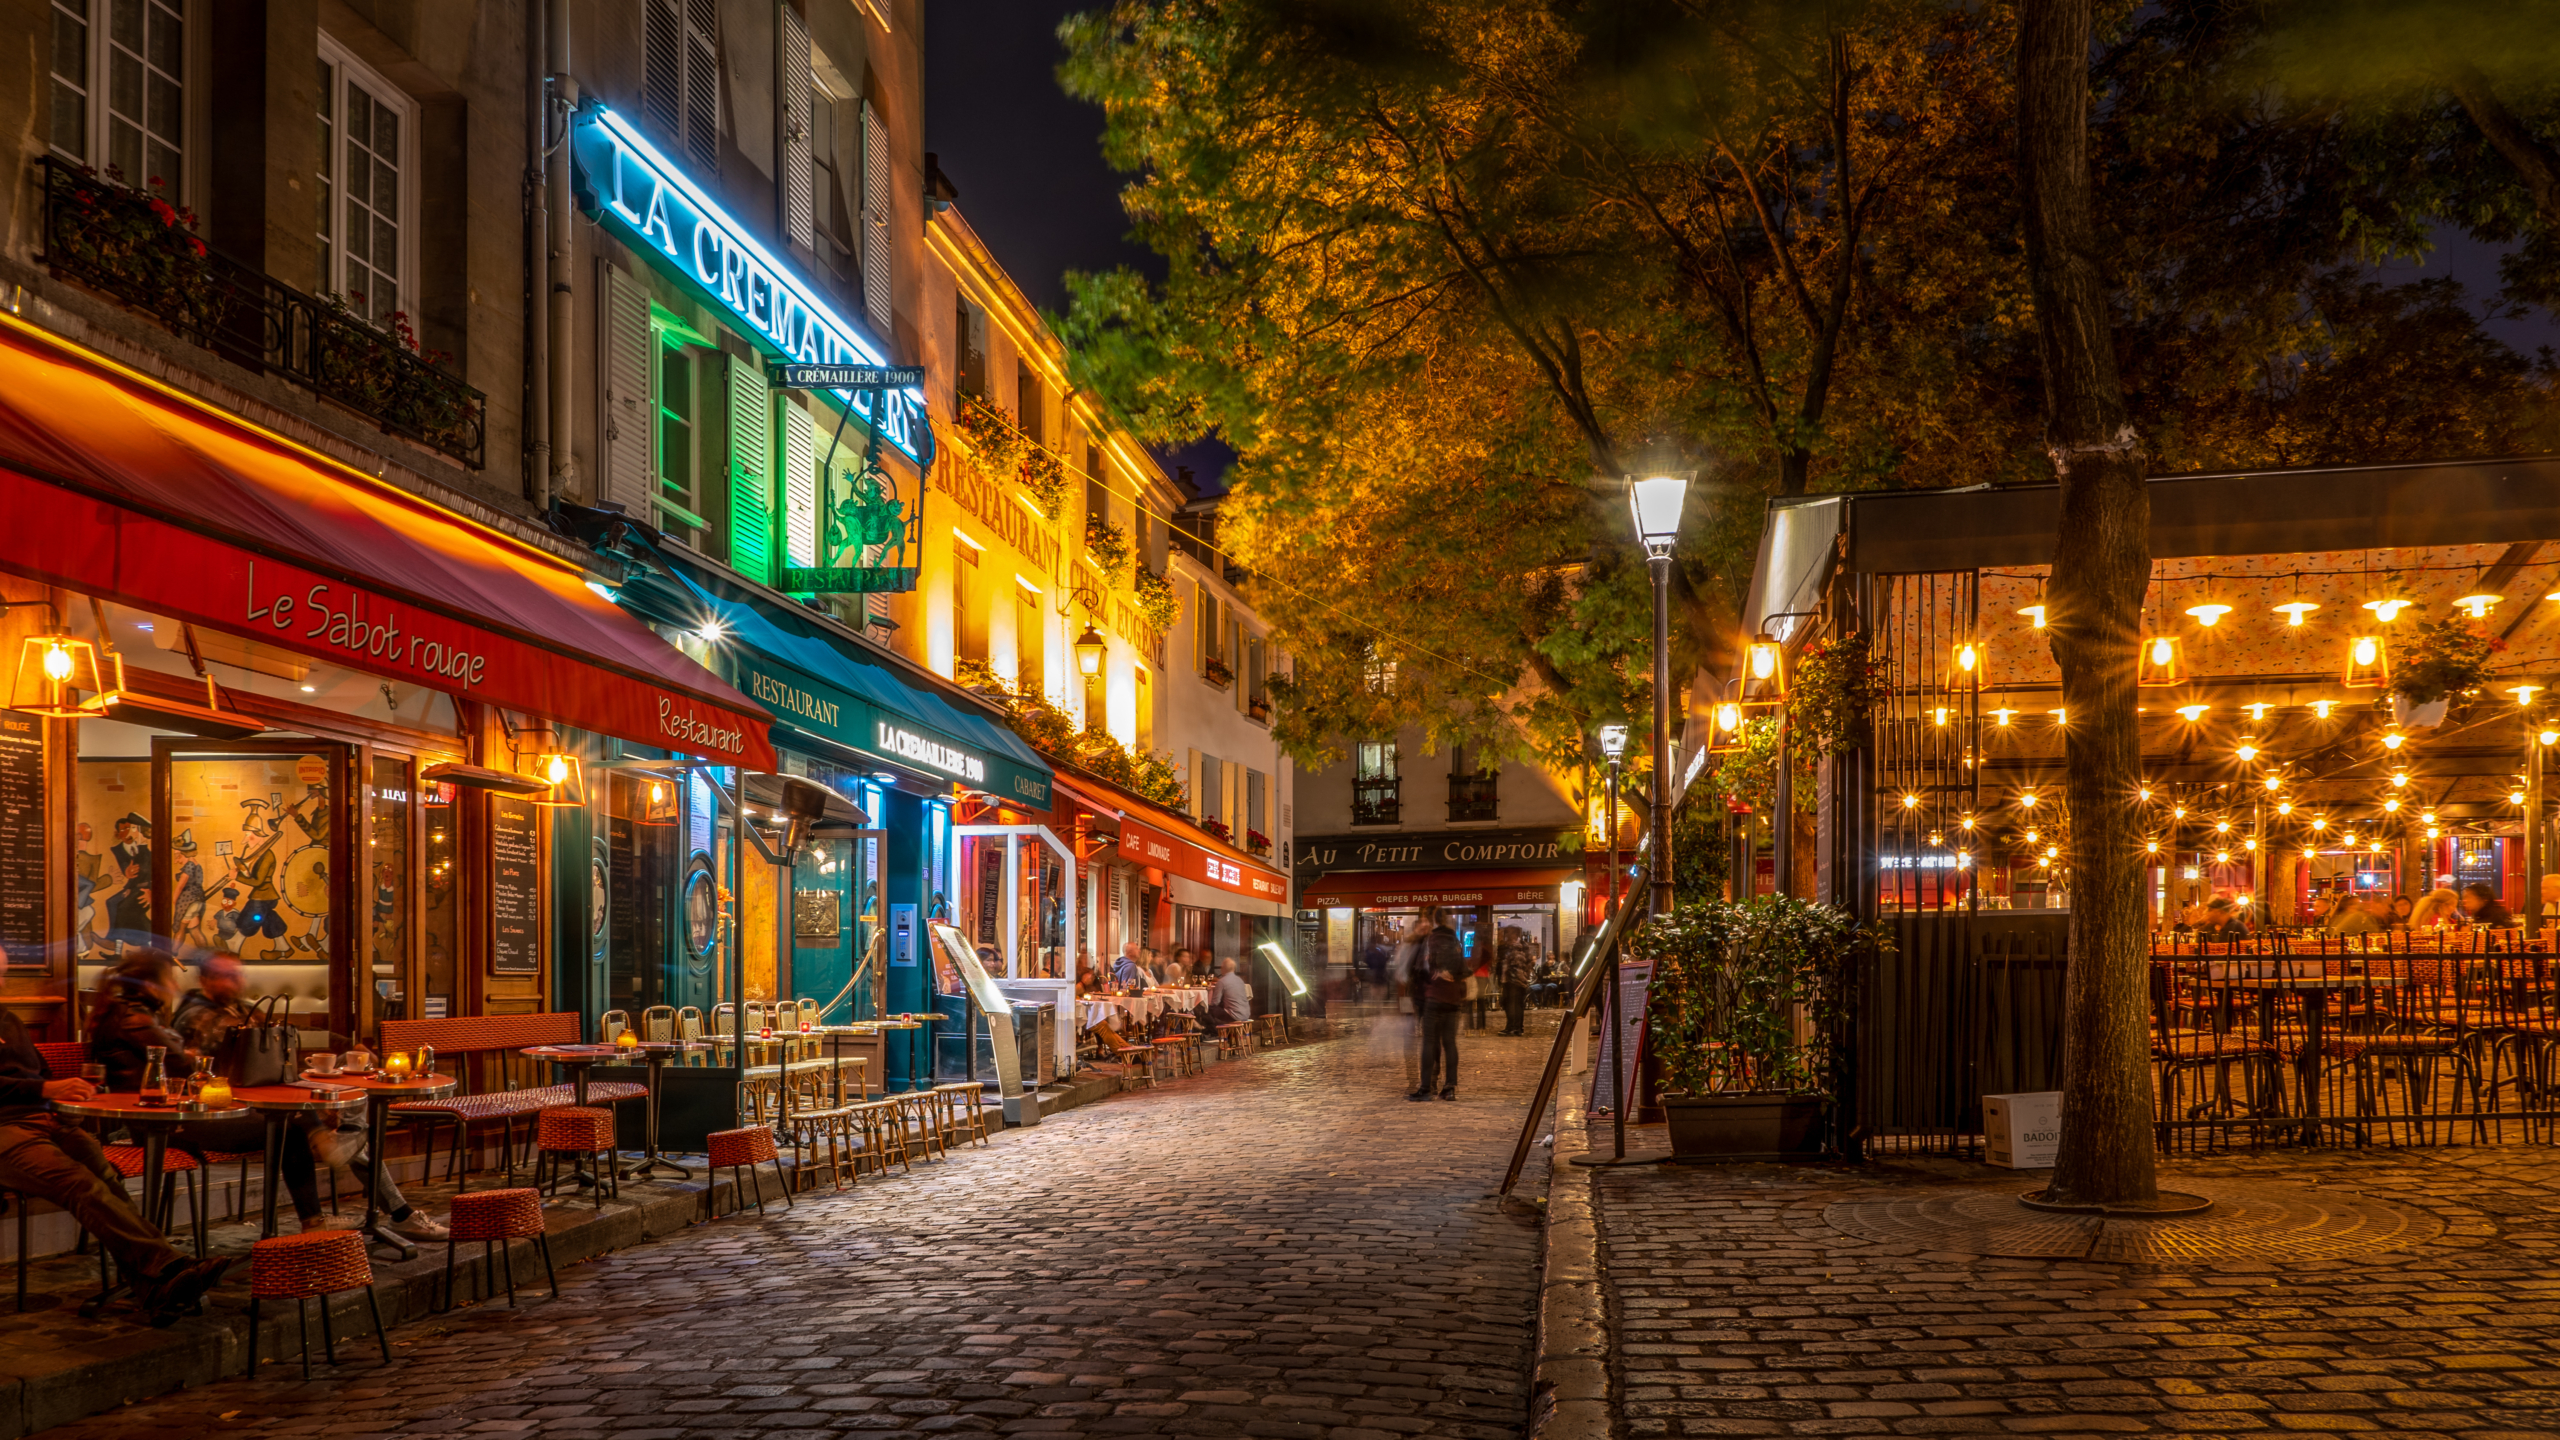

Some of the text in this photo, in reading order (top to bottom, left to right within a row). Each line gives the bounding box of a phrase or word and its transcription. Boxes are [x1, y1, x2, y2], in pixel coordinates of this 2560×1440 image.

[608, 140, 678, 256] LA
[776, 370, 793, 382] LA
[797, 368, 879, 384] CRÉMAILLÈRE
[934, 436, 1062, 583] RESTAURANT
[1069, 558, 1109, 627] CHEZ
[248, 560, 485, 690] Le Sabot rouge
[752, 670, 840, 728] RESTAURANT
[659, 694, 745, 755] Restaurant
[1014, 774, 1047, 801] CABARET
[1126, 832, 1140, 851] CAFE
[1147, 843, 1171, 862] LIMONADE
[1297, 845, 1337, 866] AU
[1356, 843, 1423, 864] PETIT
[1443, 841, 1559, 862] COMPTOIR
[1317, 890, 1545, 906] PIZZA CREPES PASTA BURGERS BIÈRE
[2023, 1132, 2060, 1143] BADOI
